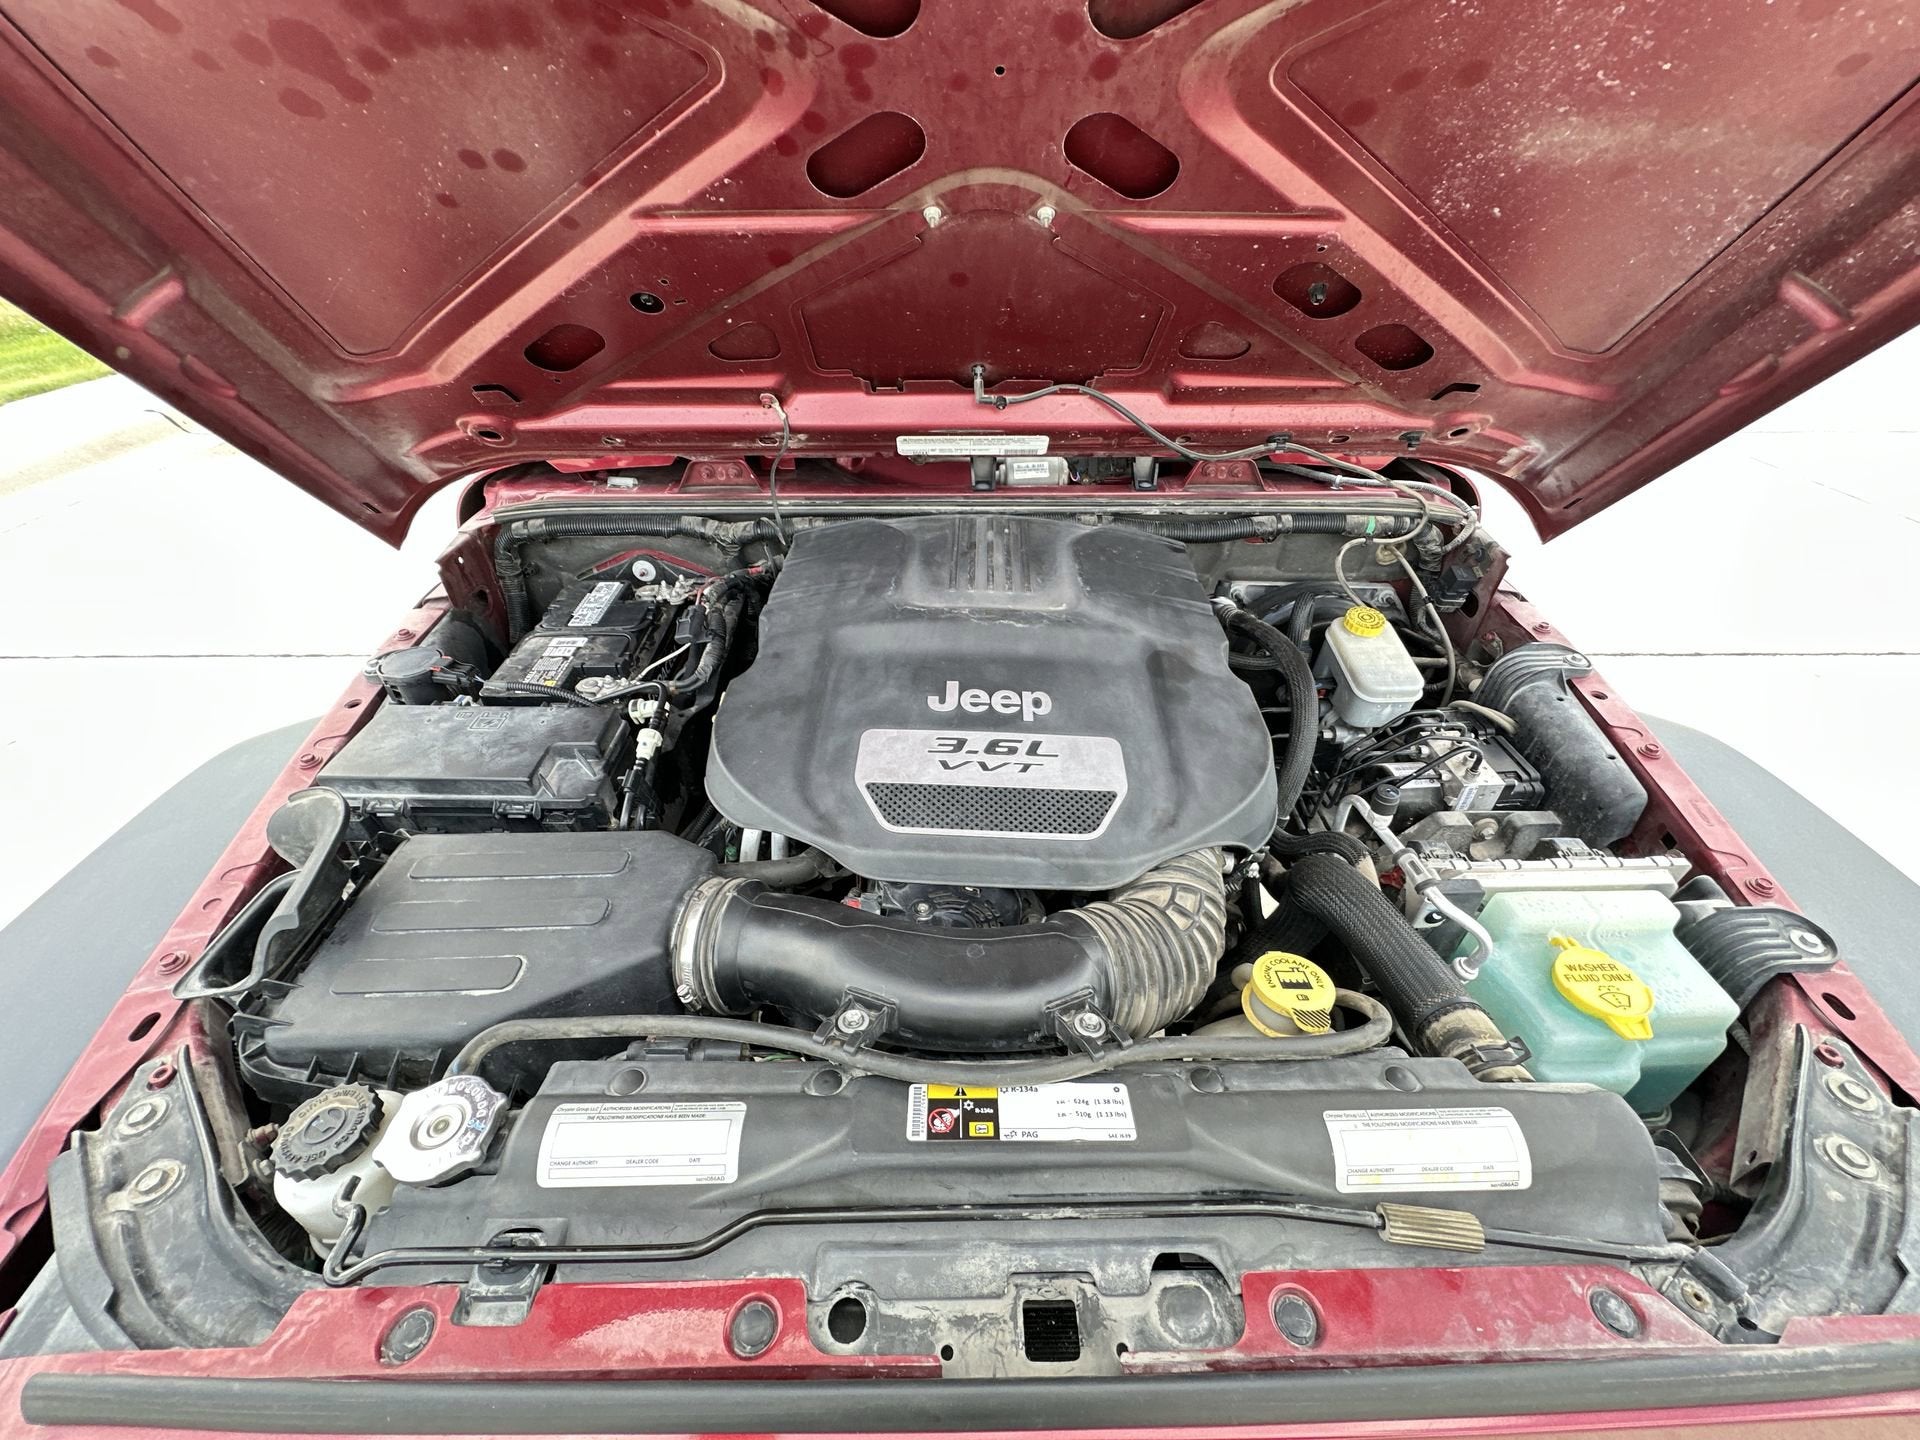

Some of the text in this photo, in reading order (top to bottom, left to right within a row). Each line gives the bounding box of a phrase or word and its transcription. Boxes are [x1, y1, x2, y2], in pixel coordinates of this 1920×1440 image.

[927, 680, 1052, 722] Jeep
[927, 736, 1059, 758] 3.6L
[938, 759, 1044, 774] VVT
[1264, 958, 1326, 989] ENGINE COOLANT ONLY
[1564, 963, 1619, 972] WASHER
[1563, 973, 1633, 982] FLUID ONLY
